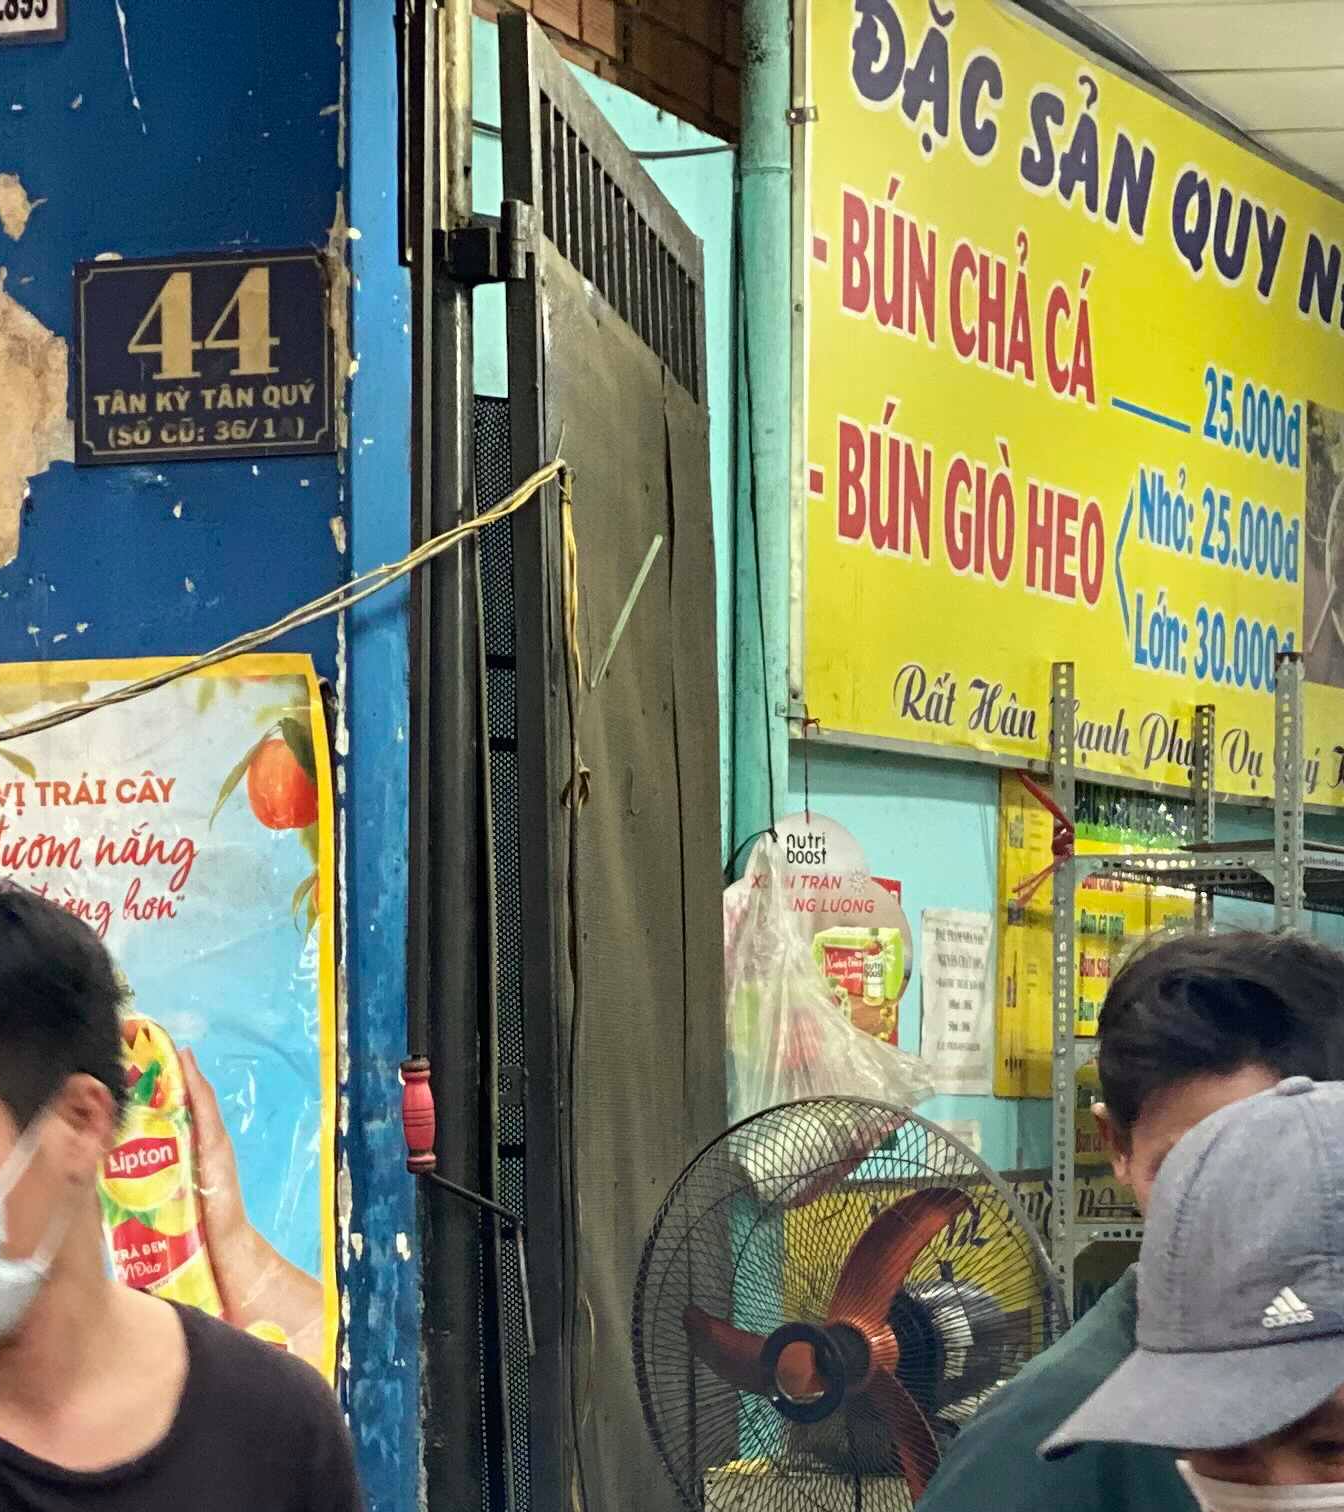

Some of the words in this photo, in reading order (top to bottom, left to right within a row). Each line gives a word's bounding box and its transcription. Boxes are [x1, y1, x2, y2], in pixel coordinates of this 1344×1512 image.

[852, 0, 1003, 157] ĐẶC
[1020, 74, 1155, 237] SẢN
[1171, 169, 1287, 298] QUY
[127, 266, 281, 380] 44
[841, 176, 937, 343] BÚN
[949, 229, 1035, 382] CHẢ
[1045, 267, 1096, 405] CÁ
[1203, 366, 1301, 469] 25.000đ
[93, 388, 148, 416] TÂN
[155, 385, 192, 413] KỲ
[201, 382, 255, 410] TÂN
[262, 378, 316, 407] QUÝ
[107, 417, 153, 448] (SỐ
[837, 401, 932, 560] BÚN
[943, 442, 1016, 582] GIÒ
[1025, 482, 1106, 605] HEO
[1138, 466, 1195, 555] Nhỏ:
[1200, 487, 1300, 584] 25.000đ
[1134, 590, 1189, 675] Lớn:
[892, 663, 957, 727] Rất
[967, 677, 1038, 741] Hân
[1051, 697, 1131, 765] ạnh
[1138, 711, 1199, 782] Phụ
[34, 772, 108, 807] TRÁI
[115, 769, 177, 804] CÂY
[94, 821, 199, 893] nắng
[786, 832, 826, 849] nutri
[786, 847, 827, 865] boost
[109, 1144, 174, 1174] Lipton
